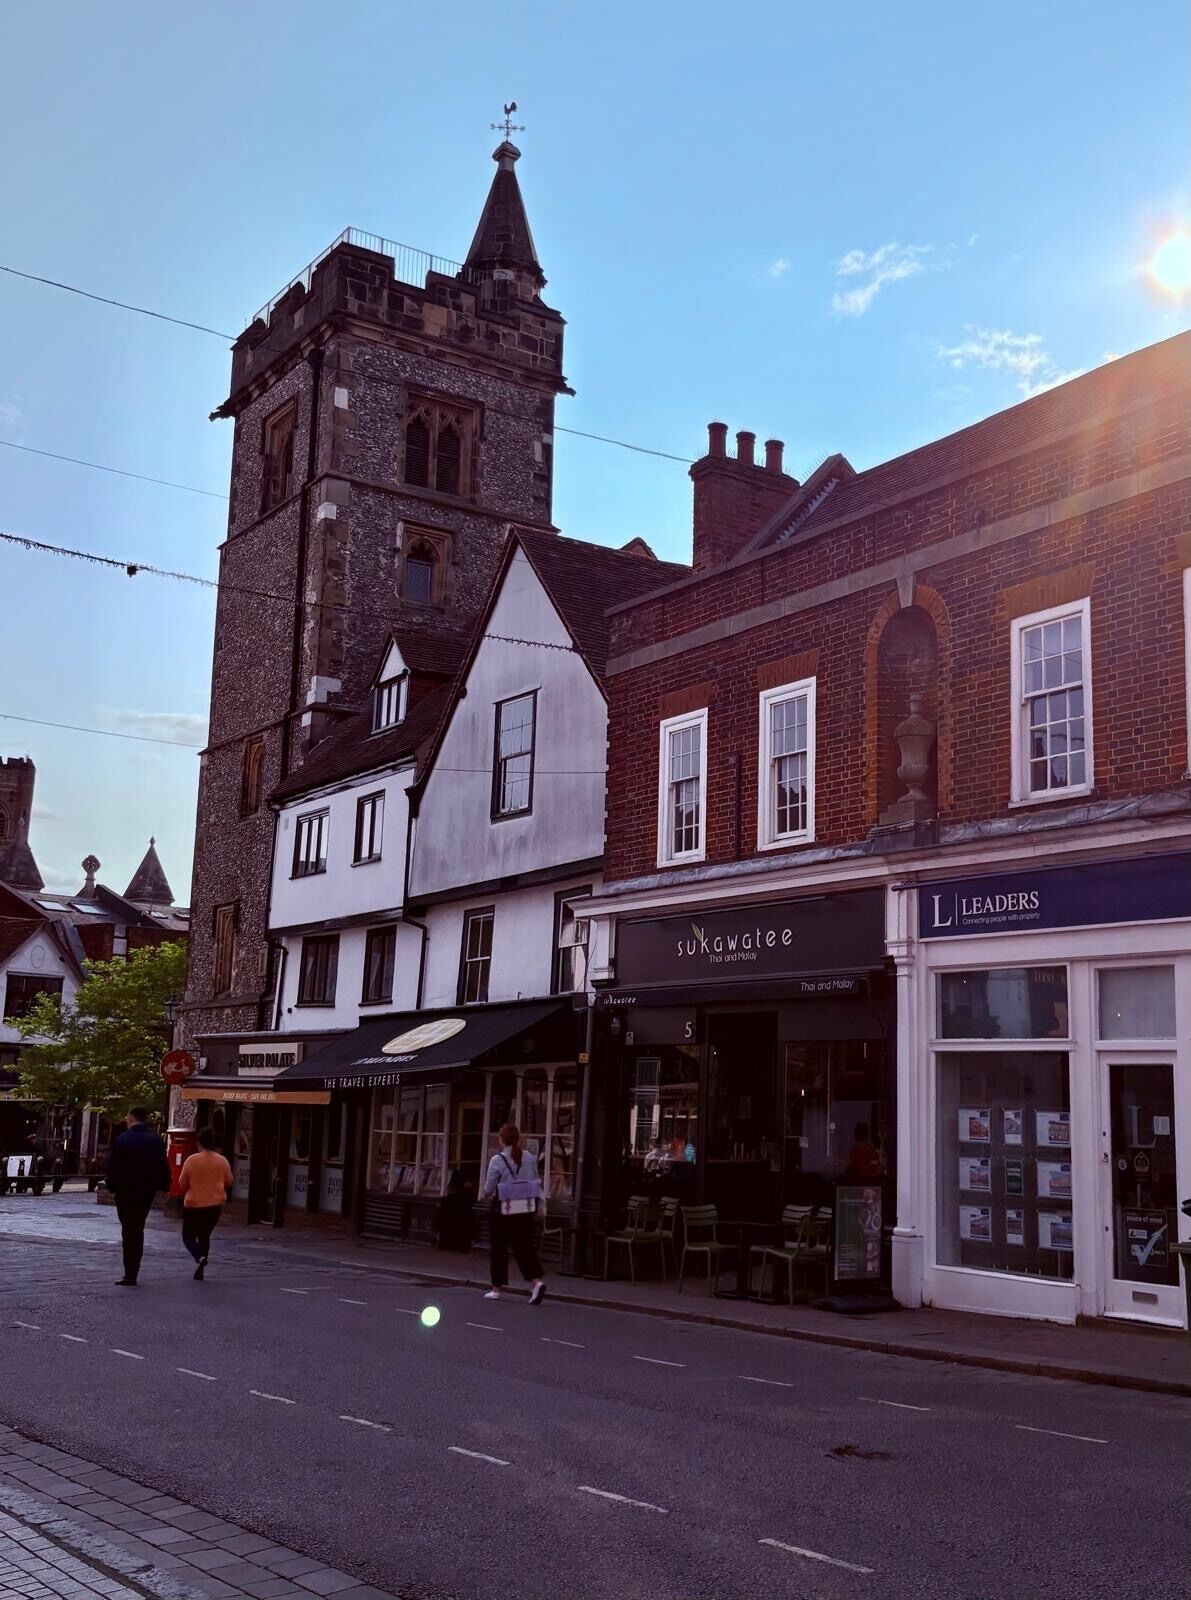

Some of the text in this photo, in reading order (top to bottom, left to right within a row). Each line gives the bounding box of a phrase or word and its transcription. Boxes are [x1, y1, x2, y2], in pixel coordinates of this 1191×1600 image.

[931, 891, 1039, 928] L LEADERS
[962, 916, 990, 925] Connecting
[990, 915, 1007, 924] people
[1019, 912, 1041, 921] property
[677, 927, 793, 957] sukawatee
[708, 951, 758, 964] Thai and Malay
[800, 979, 855, 991] Thai and Malay
[684, 1021, 693, 1038] 5
[238, 1052, 295, 1068] SILVER PALATE
[323, 1073, 401, 1089] THE TRAVEL EXPERTS
